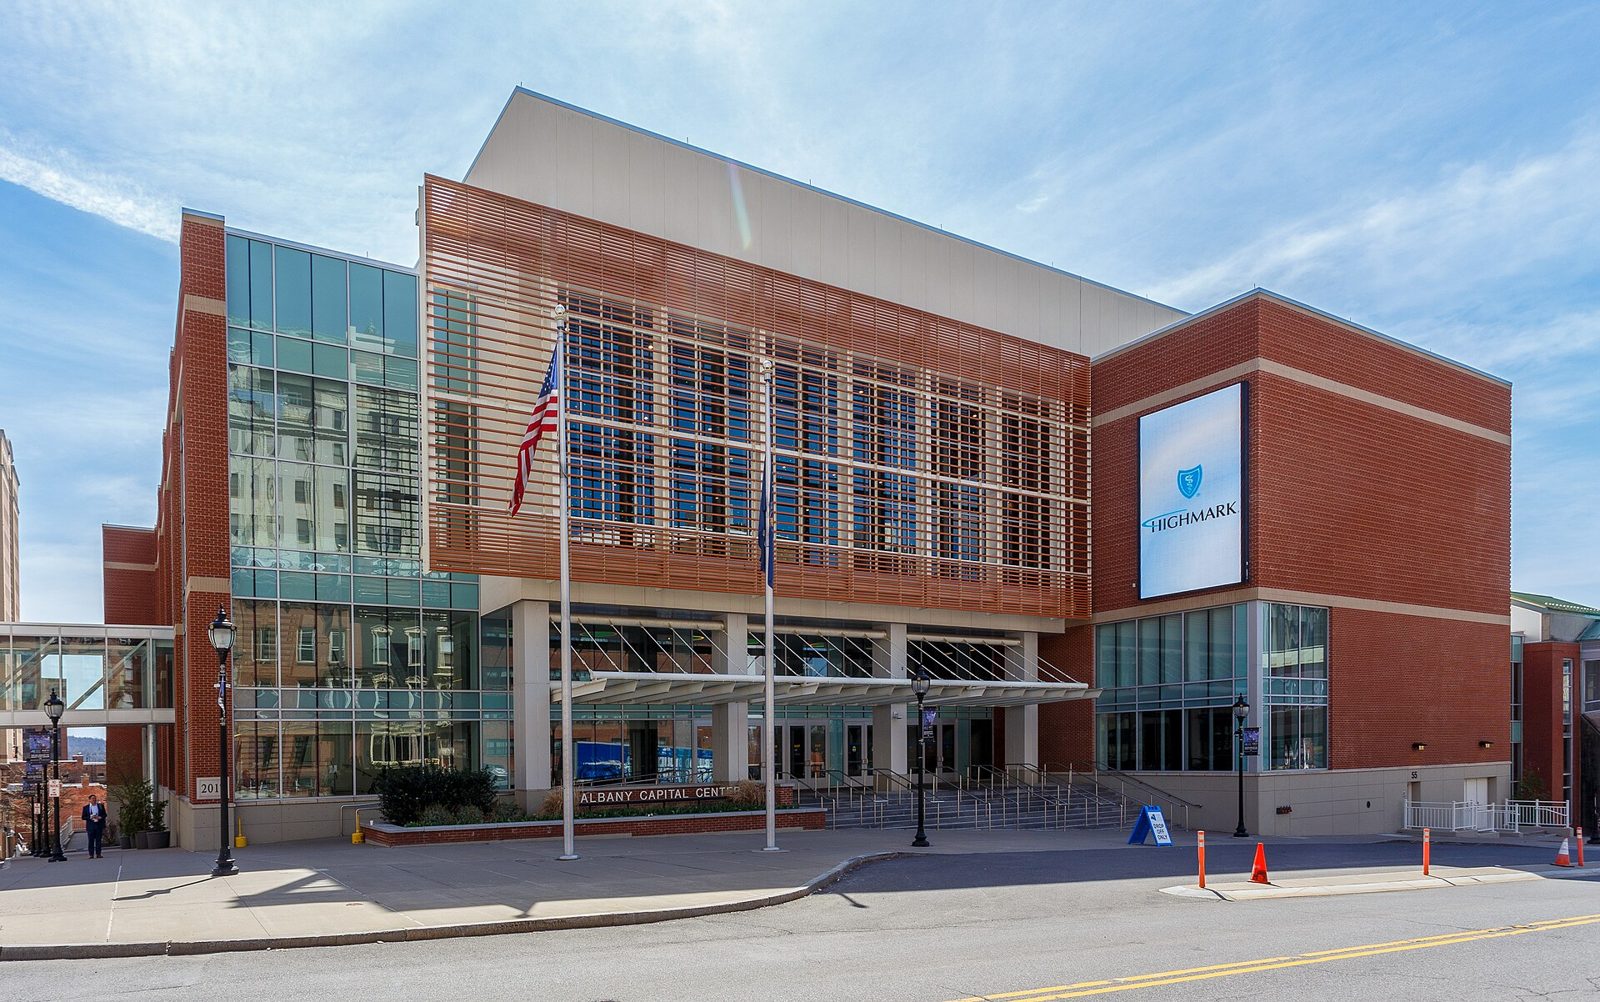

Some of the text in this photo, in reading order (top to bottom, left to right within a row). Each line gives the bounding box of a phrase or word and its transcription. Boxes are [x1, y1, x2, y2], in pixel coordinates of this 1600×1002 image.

[1151, 501, 1237, 533] HIGHMARK
[1411, 771, 1418, 779] 55
[201, 783, 221, 794] 201
[580, 791, 633, 804] ALBANY
[639, 788, 689, 801] CAPITAL
